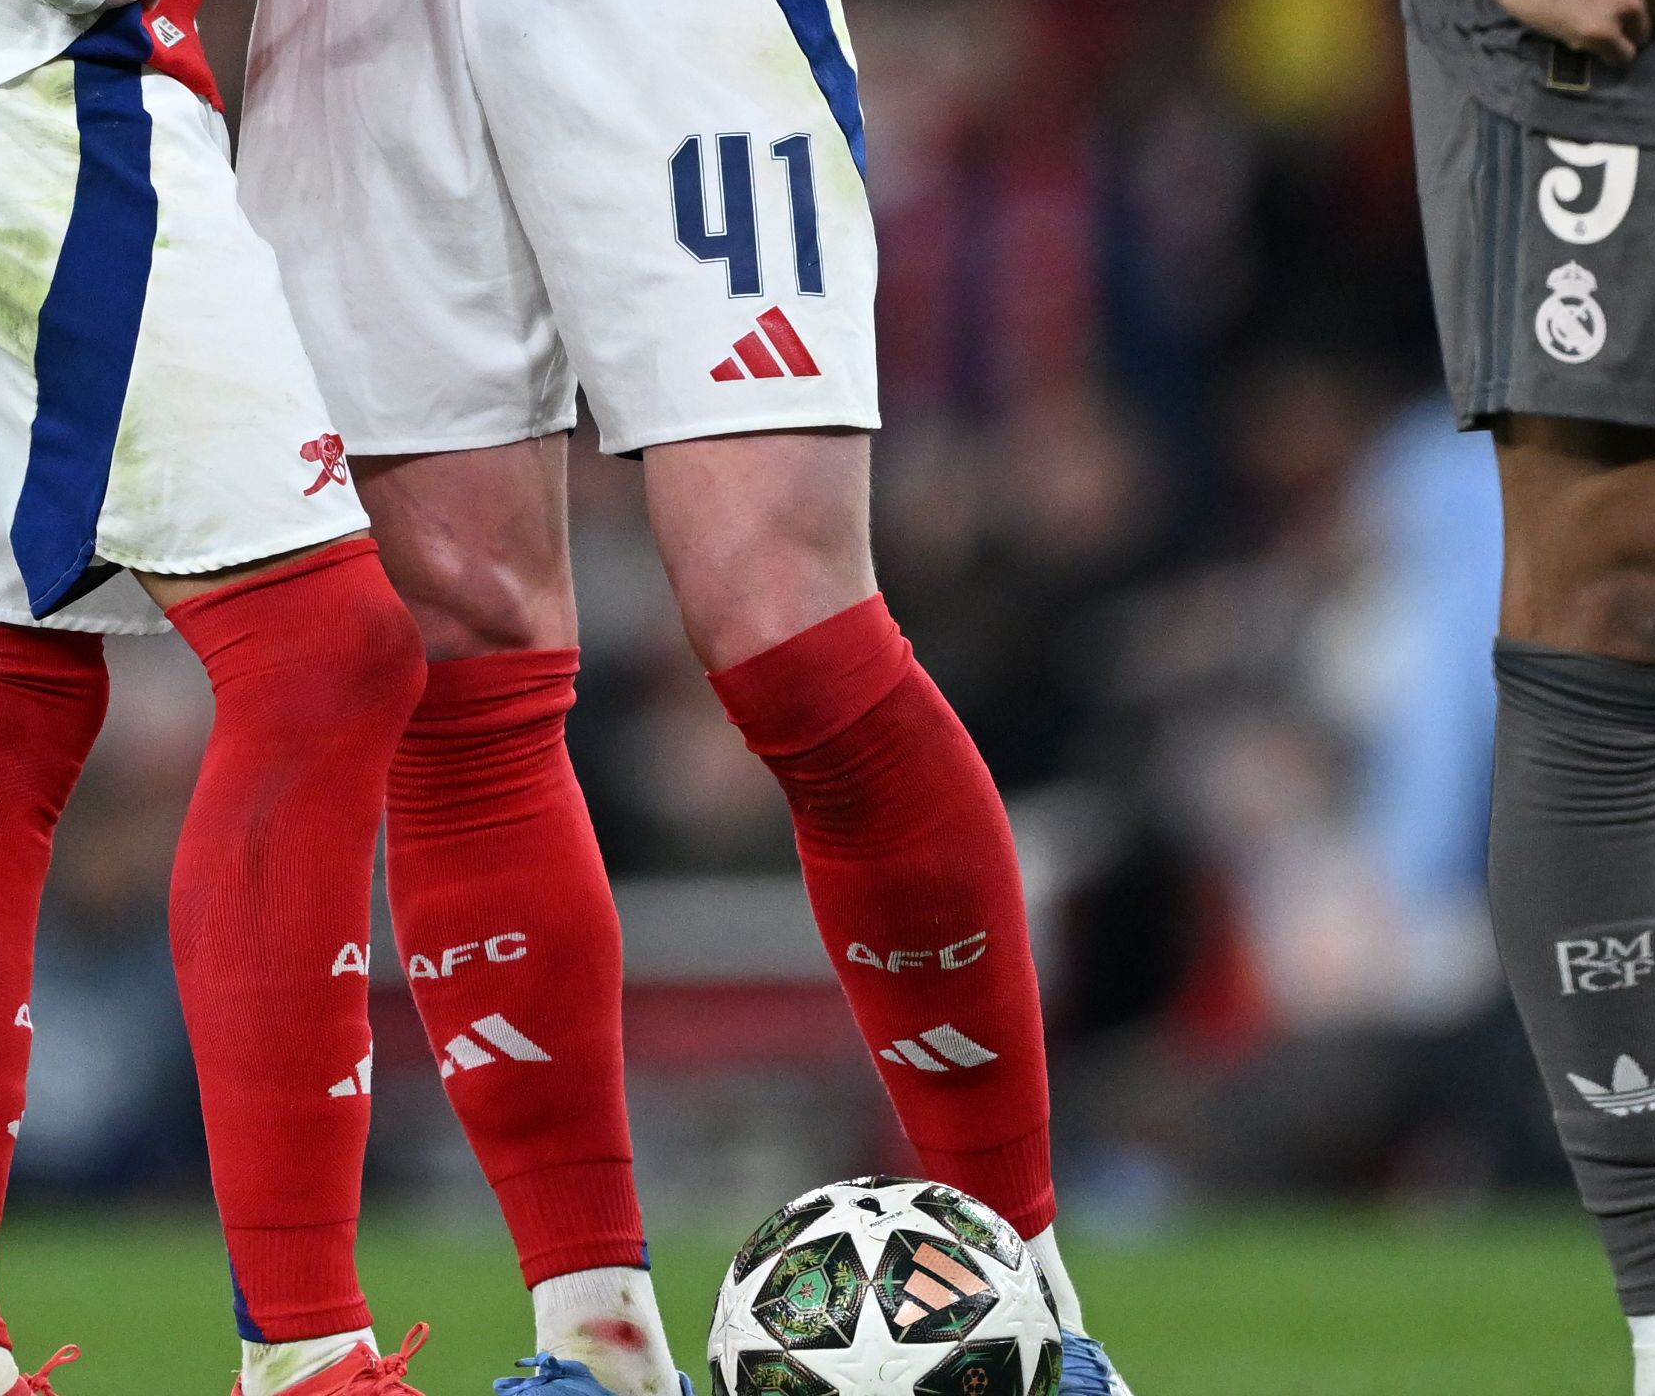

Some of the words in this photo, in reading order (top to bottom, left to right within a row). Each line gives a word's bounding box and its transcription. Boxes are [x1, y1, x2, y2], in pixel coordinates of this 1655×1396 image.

[667, 132, 826, 299] 41
[408, 932, 527, 981] AFC
[846, 930, 987, 974] AFC
